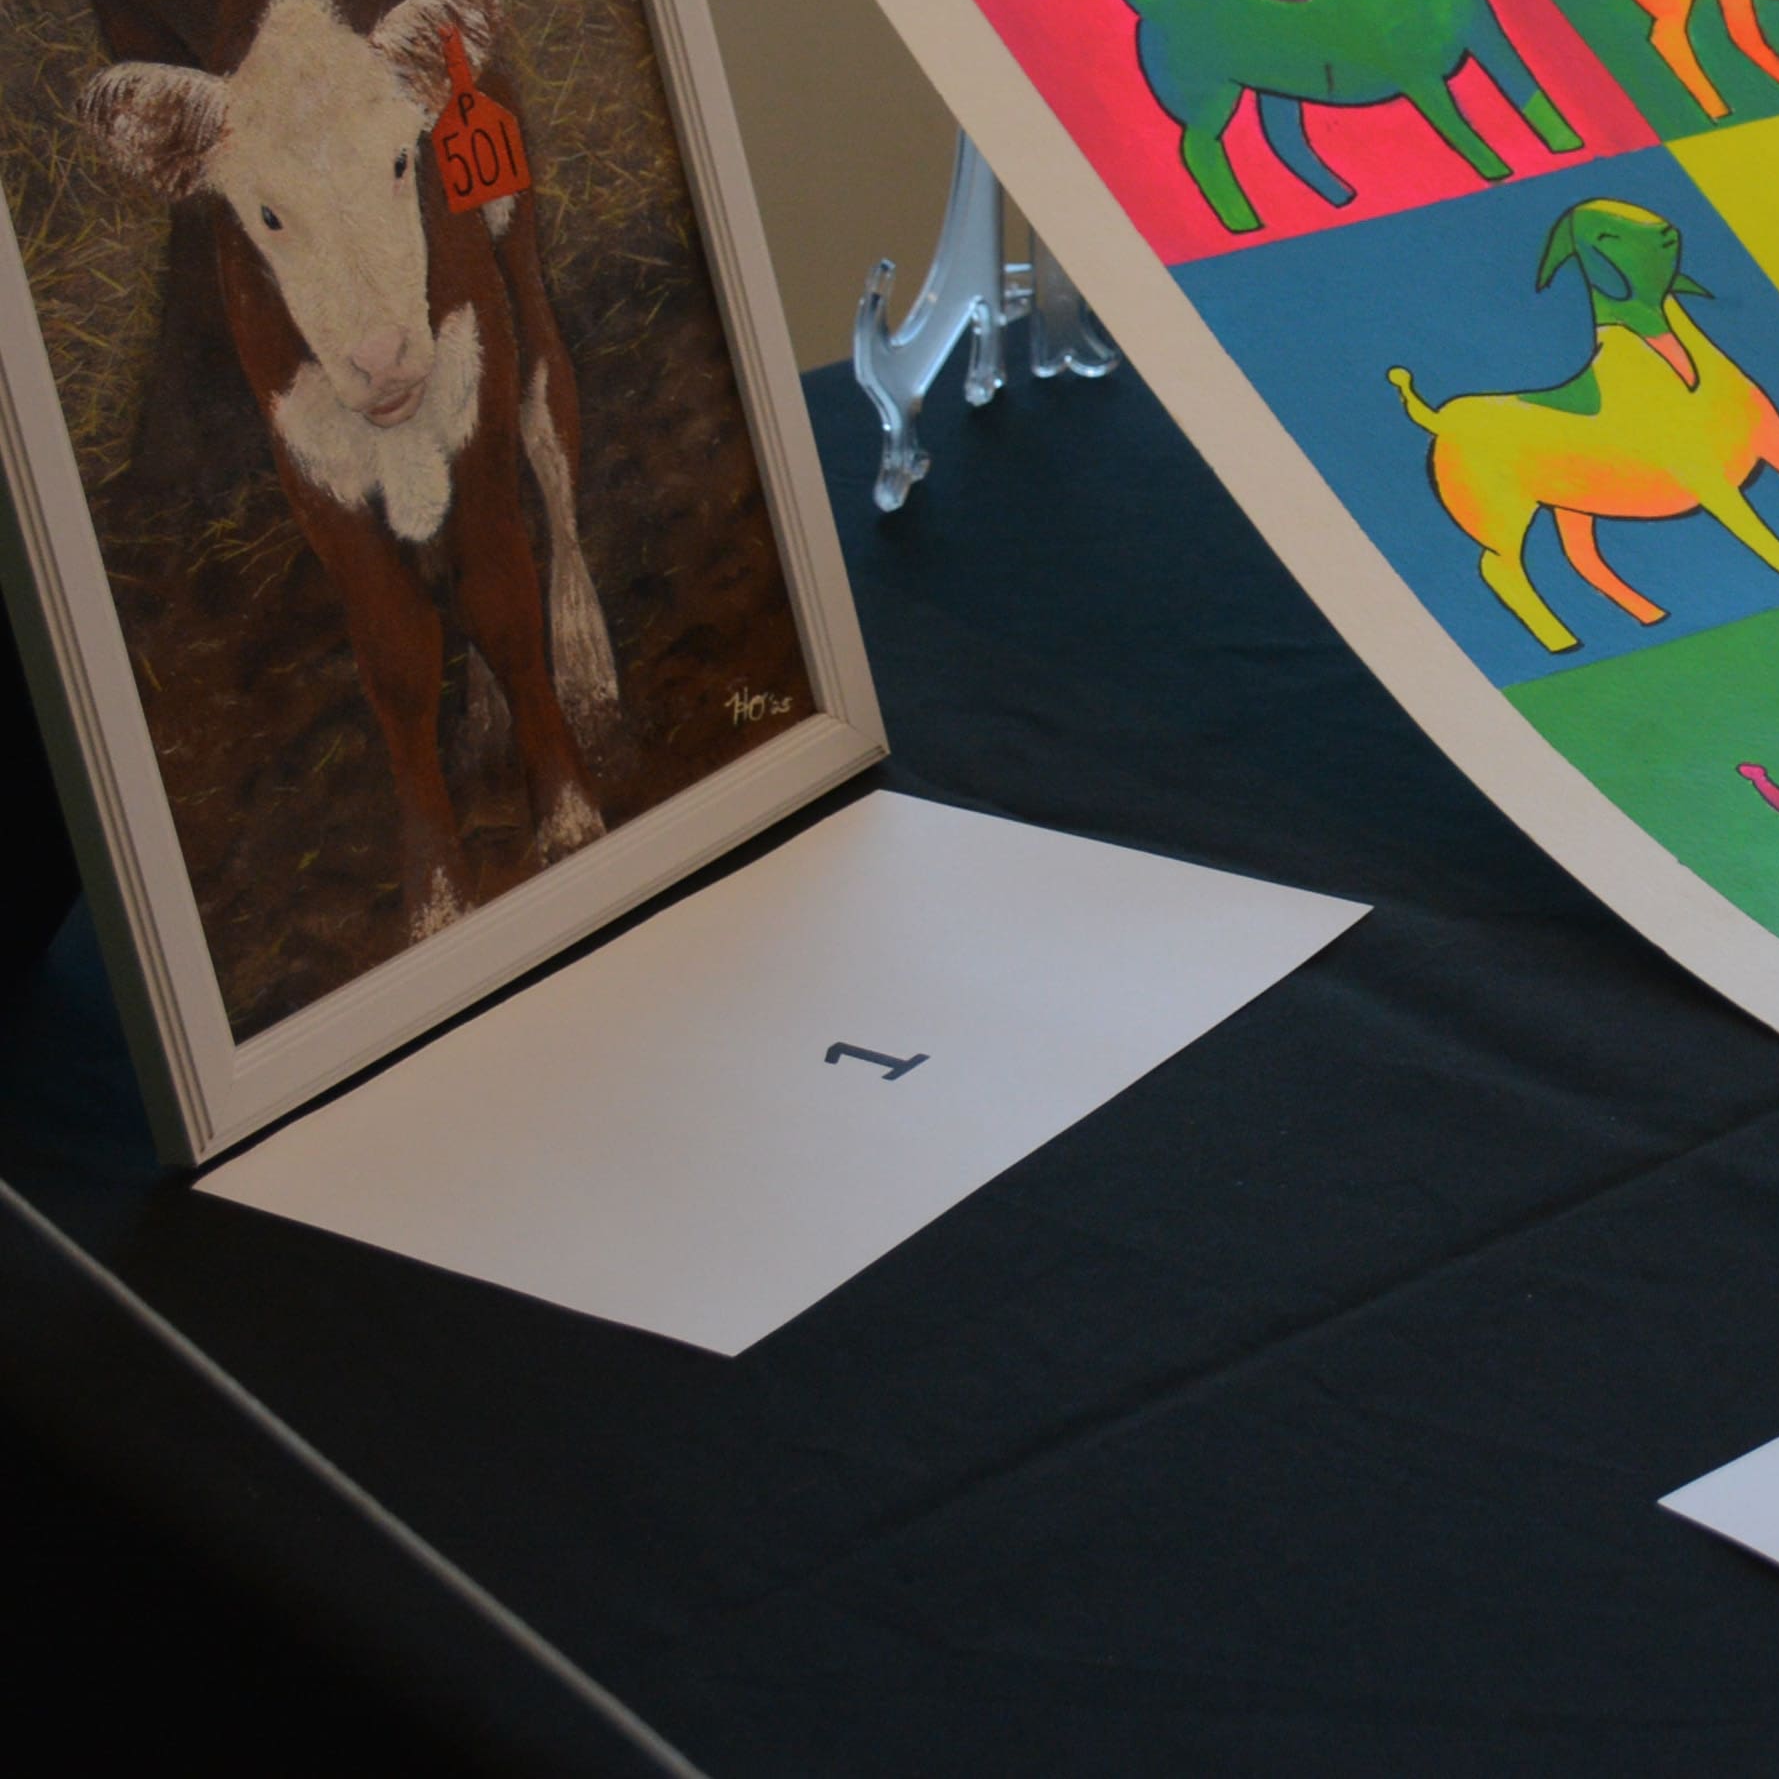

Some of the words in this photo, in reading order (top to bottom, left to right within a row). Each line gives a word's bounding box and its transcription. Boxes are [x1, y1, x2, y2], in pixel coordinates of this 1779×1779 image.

[457, 92, 476, 127] P
[442, 118, 518, 197] 501
[824, 1041, 931, 1081] 1
